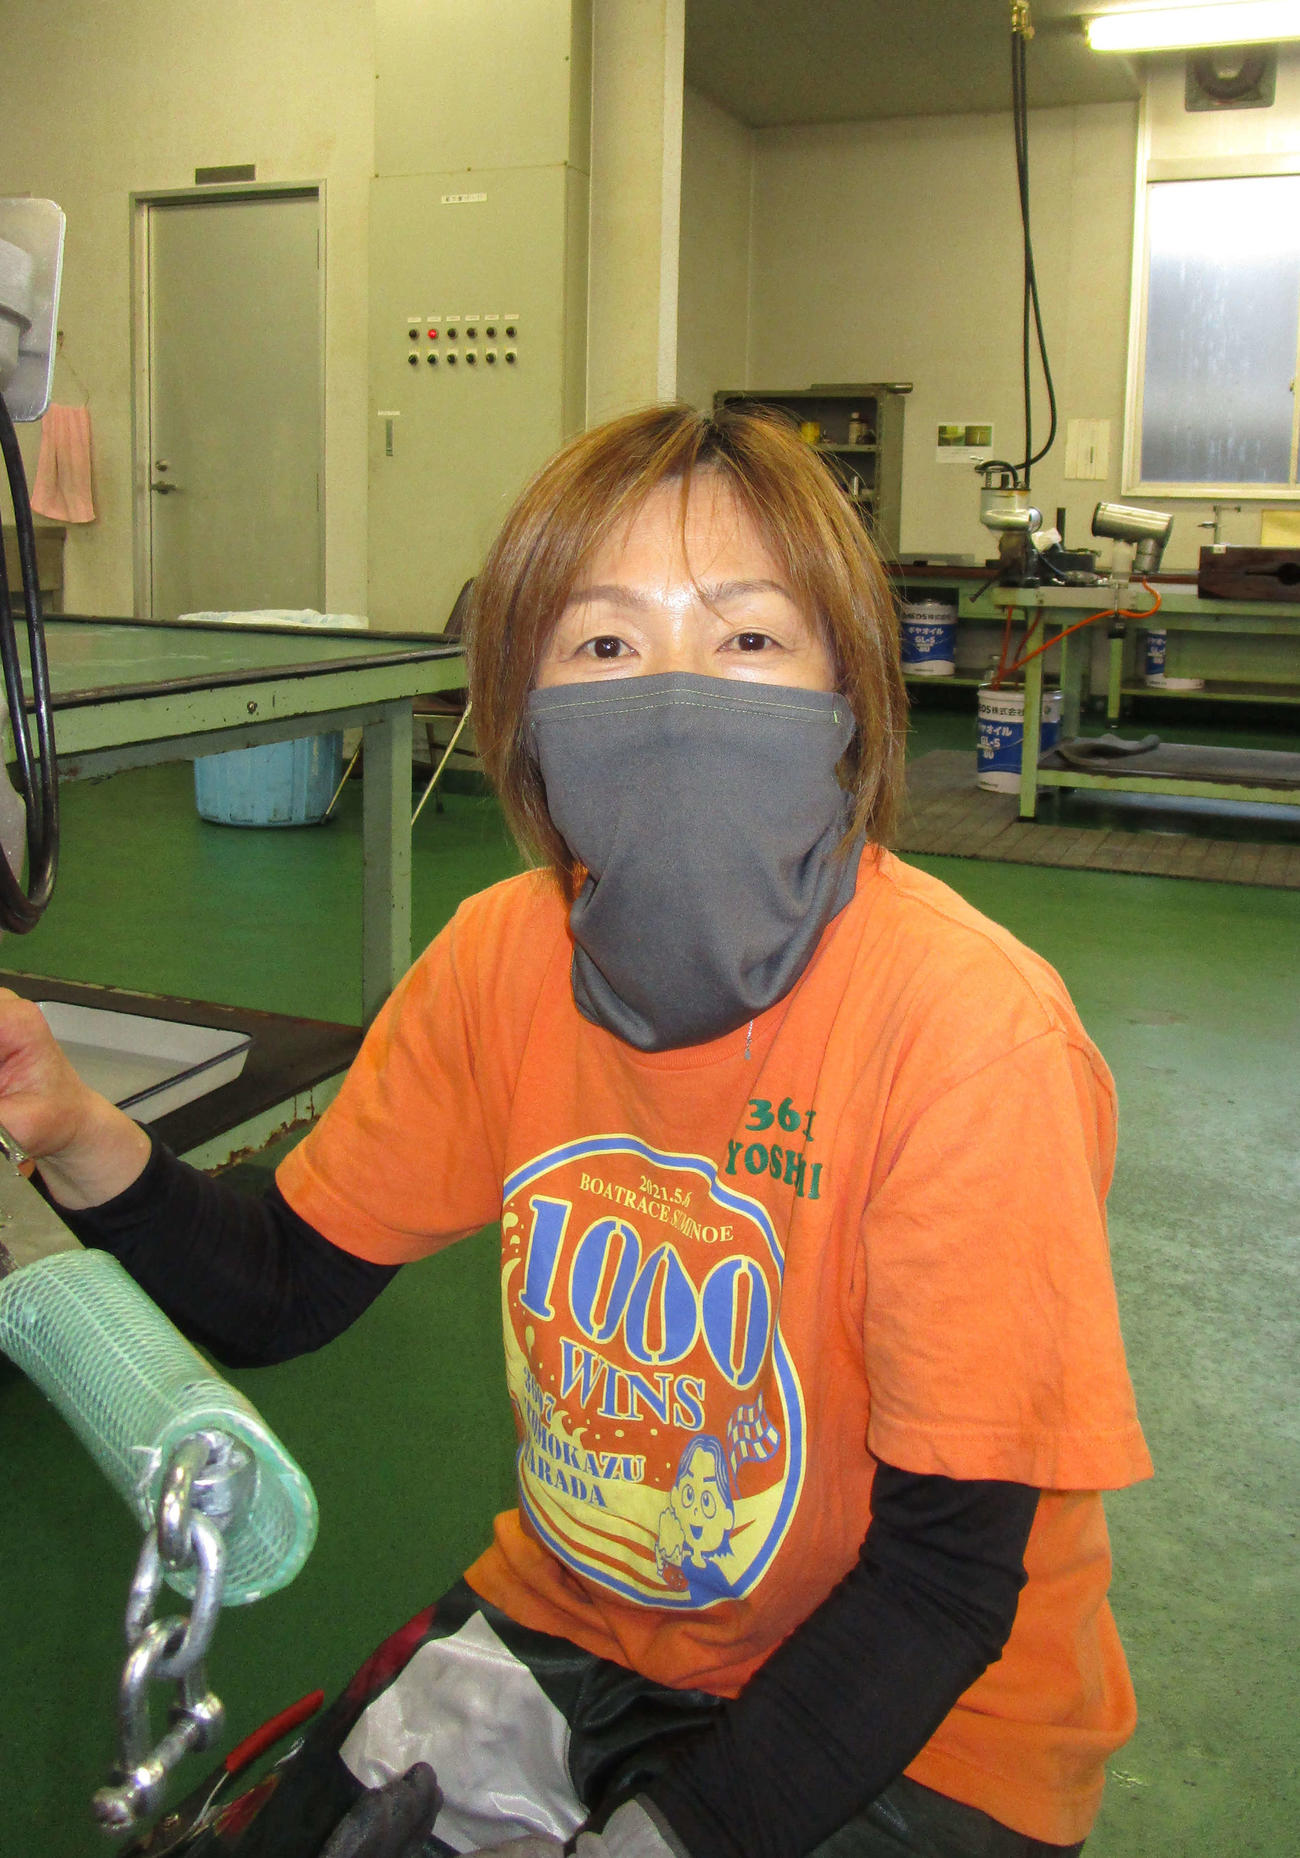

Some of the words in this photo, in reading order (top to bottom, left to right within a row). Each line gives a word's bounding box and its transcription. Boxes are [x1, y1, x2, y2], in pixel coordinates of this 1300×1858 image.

[579, 1172, 672, 1223] BOATRACE
[724, 1138, 823, 1200] YOSHI
[518, 1193, 773, 1391] 1000
[559, 1335, 706, 1432] WINS
